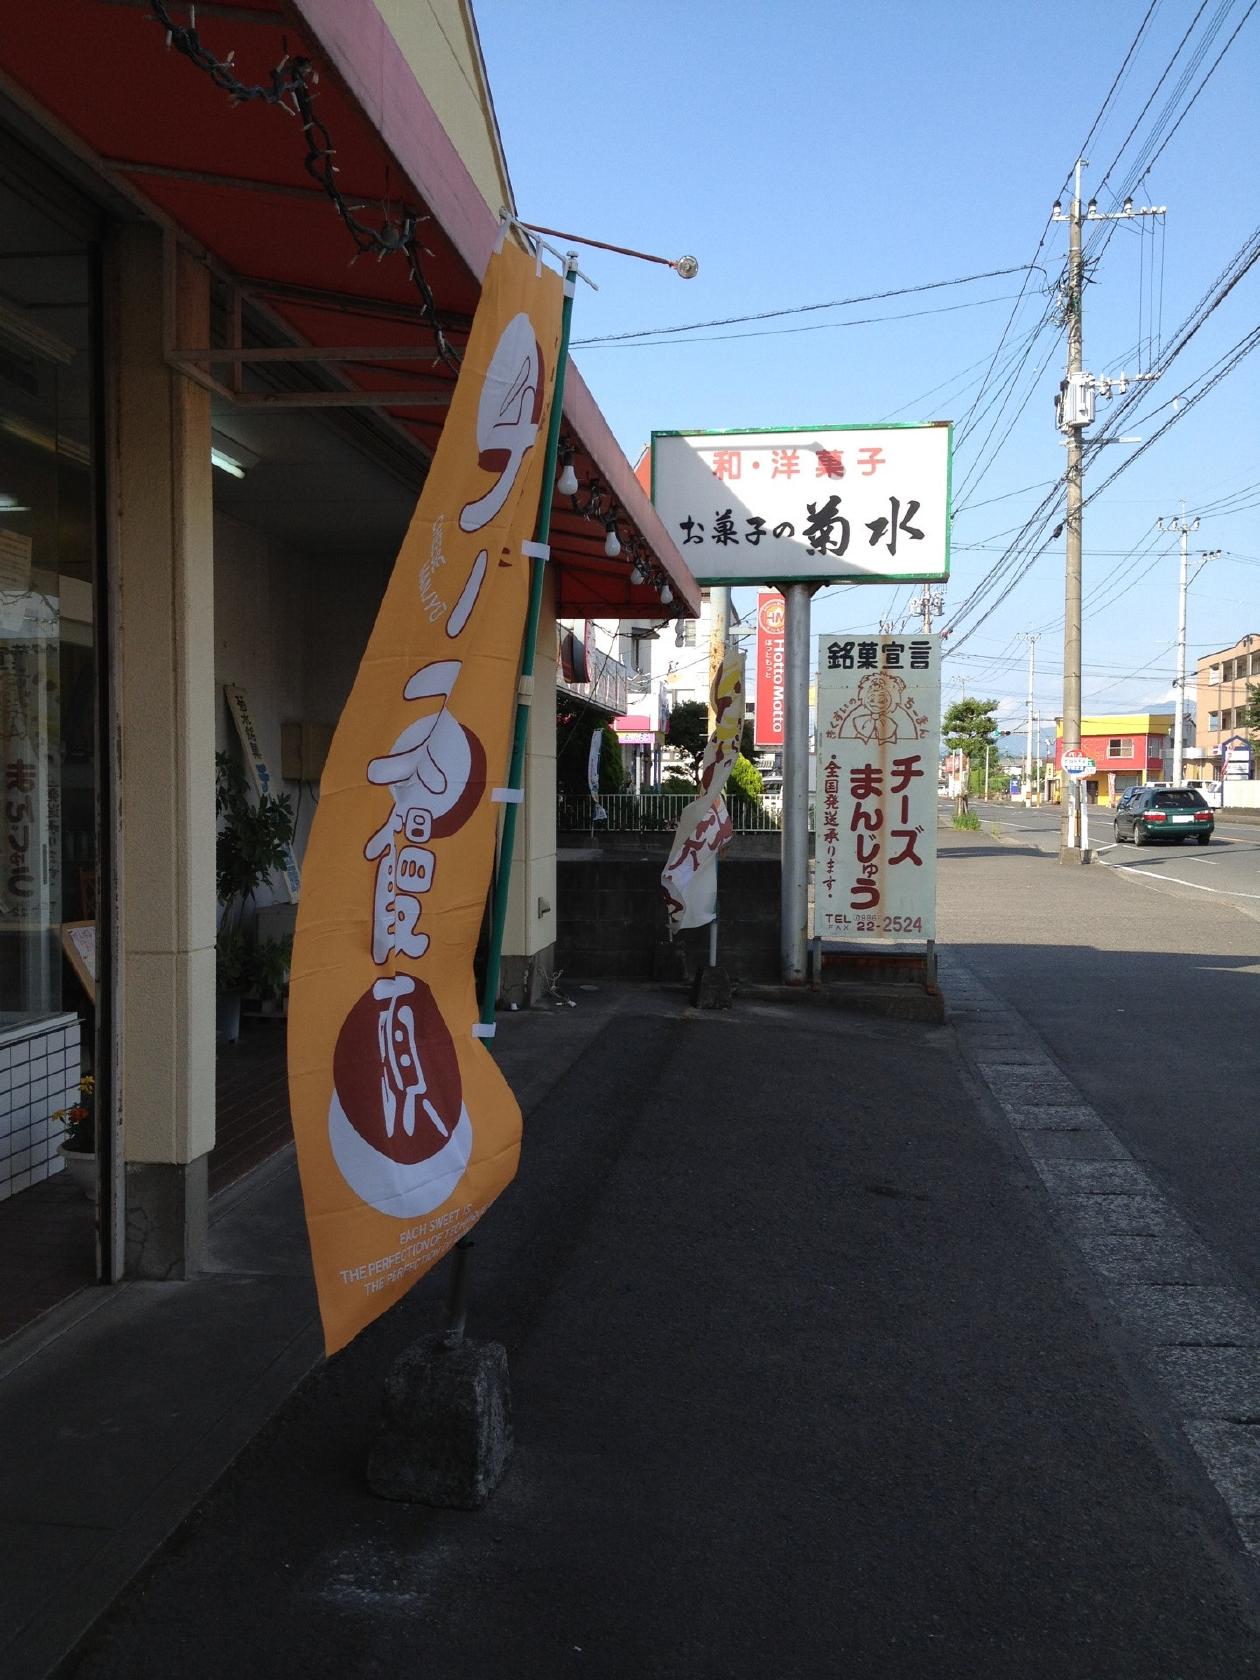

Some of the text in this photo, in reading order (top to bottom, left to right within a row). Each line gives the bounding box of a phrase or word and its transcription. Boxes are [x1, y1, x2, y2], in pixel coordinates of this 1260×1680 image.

[712, 447, 886, 480] 和・洋菓子
[679, 494, 926, 557] お菓子の菊水
[827, 641, 932, 670] 銘菓宣言
[888, 754, 925, 867] チーズ
[850, 763, 885, 910] まんじゅう
[825, 914, 851, 924] TEL
[399, 1223, 427, 1246] EACH
[339, 1264, 368, 1285] THE
[368, 1238, 431, 1276] PERFECTION
[363, 1276, 386, 1297] THE
